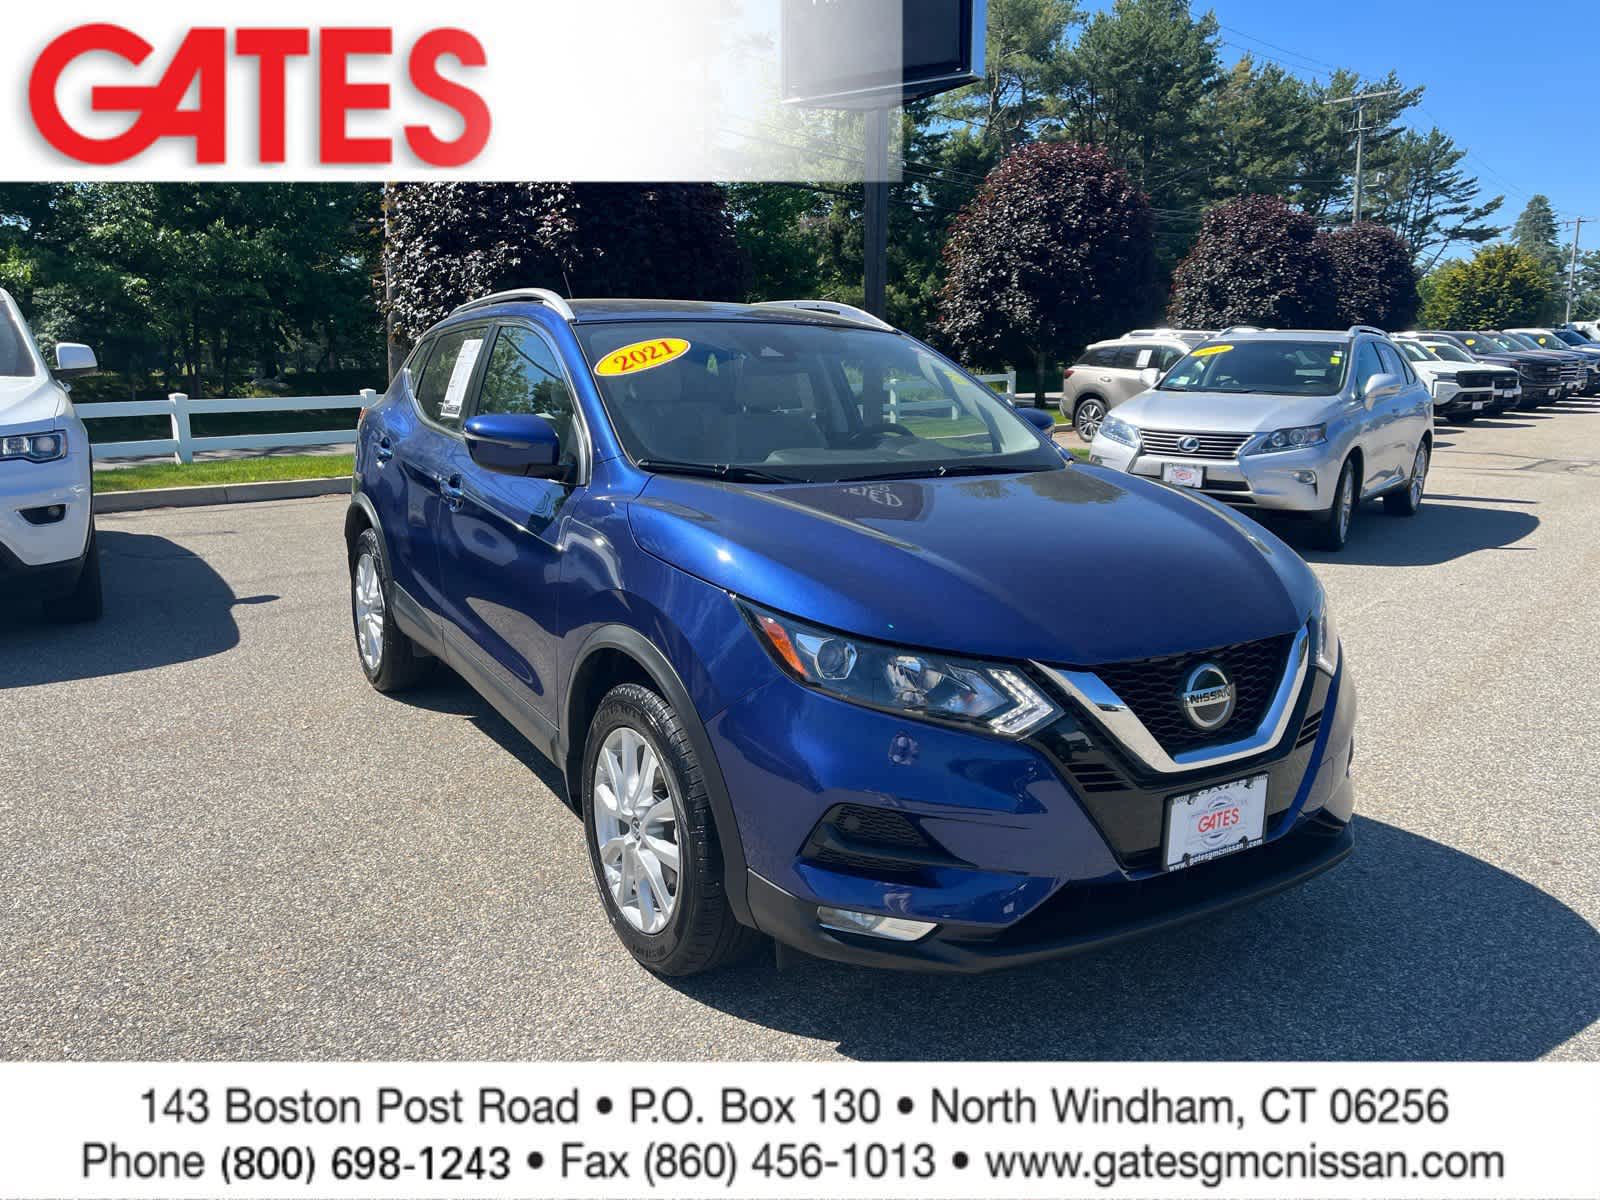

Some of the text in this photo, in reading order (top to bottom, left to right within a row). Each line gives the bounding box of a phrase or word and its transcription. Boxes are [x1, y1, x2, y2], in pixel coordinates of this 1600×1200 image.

[613, 341, 675, 371] 2021
[1190, 685, 1232, 704] NISSAN
[1198, 807, 1240, 833] GATES
